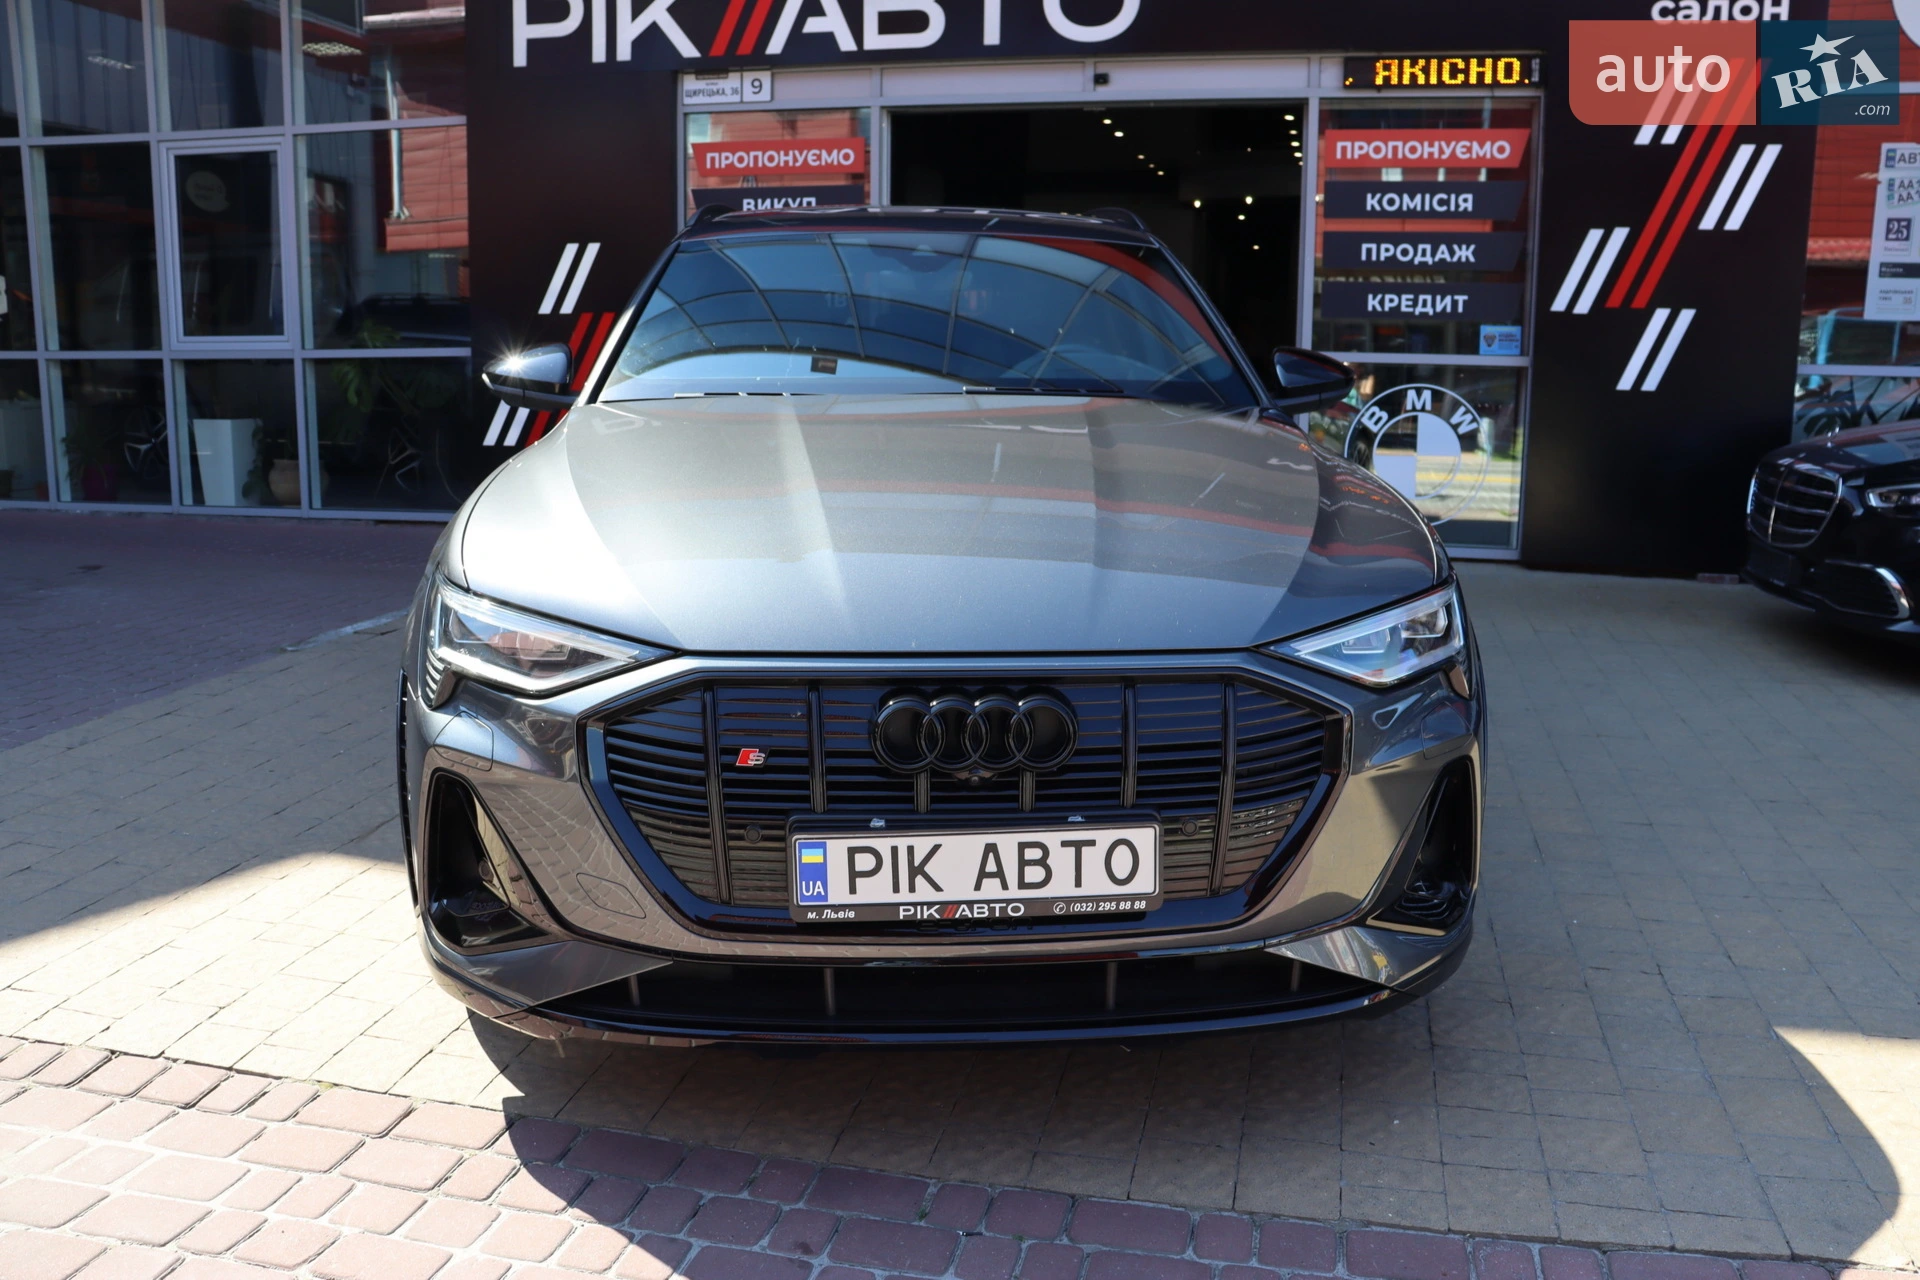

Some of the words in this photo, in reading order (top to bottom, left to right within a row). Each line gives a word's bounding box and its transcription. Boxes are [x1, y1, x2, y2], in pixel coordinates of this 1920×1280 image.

[1650, 0, 1790, 24] салон
[751, 77, 763, 95] 9
[706, 148, 855, 169] ПРОПОНУЄМО
[1335, 139, 1511, 160] ПРОПОНУЄМО
[1366, 193, 1474, 212] КОМІСІЯ
[1888, 221, 1908, 240] 25
[1360, 243, 1476, 265] ПРОДАЖ
[1367, 293, 1469, 316] КРЕДИТ
[973, 838, 1140, 891] АВТО
[802, 881, 825, 896] UA
[821, 909, 856, 919] Львів
[1069, 902, 1096, 912] (032)
[1098, 901, 1117, 911] 295
[1119, 901, 1132, 910] 88
[1133, 900, 1146, 909] 88
